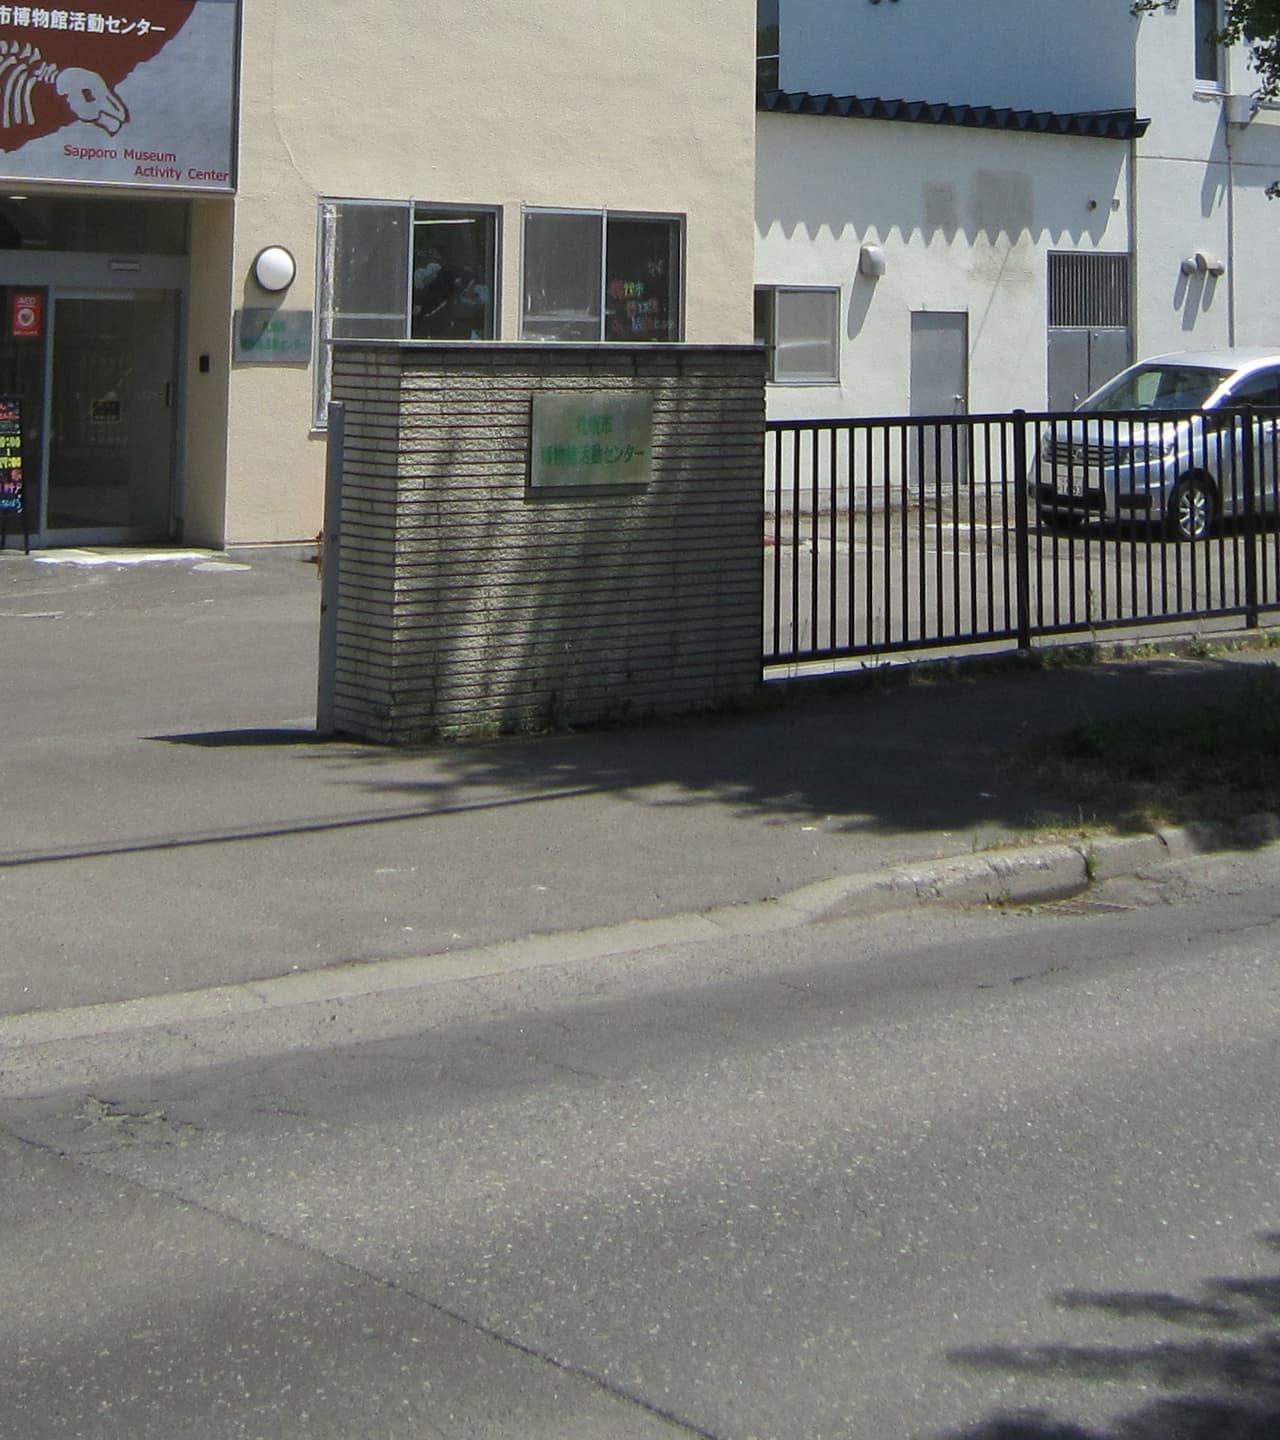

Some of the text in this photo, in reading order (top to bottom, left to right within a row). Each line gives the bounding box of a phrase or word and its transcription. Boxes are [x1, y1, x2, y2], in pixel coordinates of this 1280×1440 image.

[63, 144, 177, 162] Sapporo Museum
[134, 165, 229, 181] Activity Center
